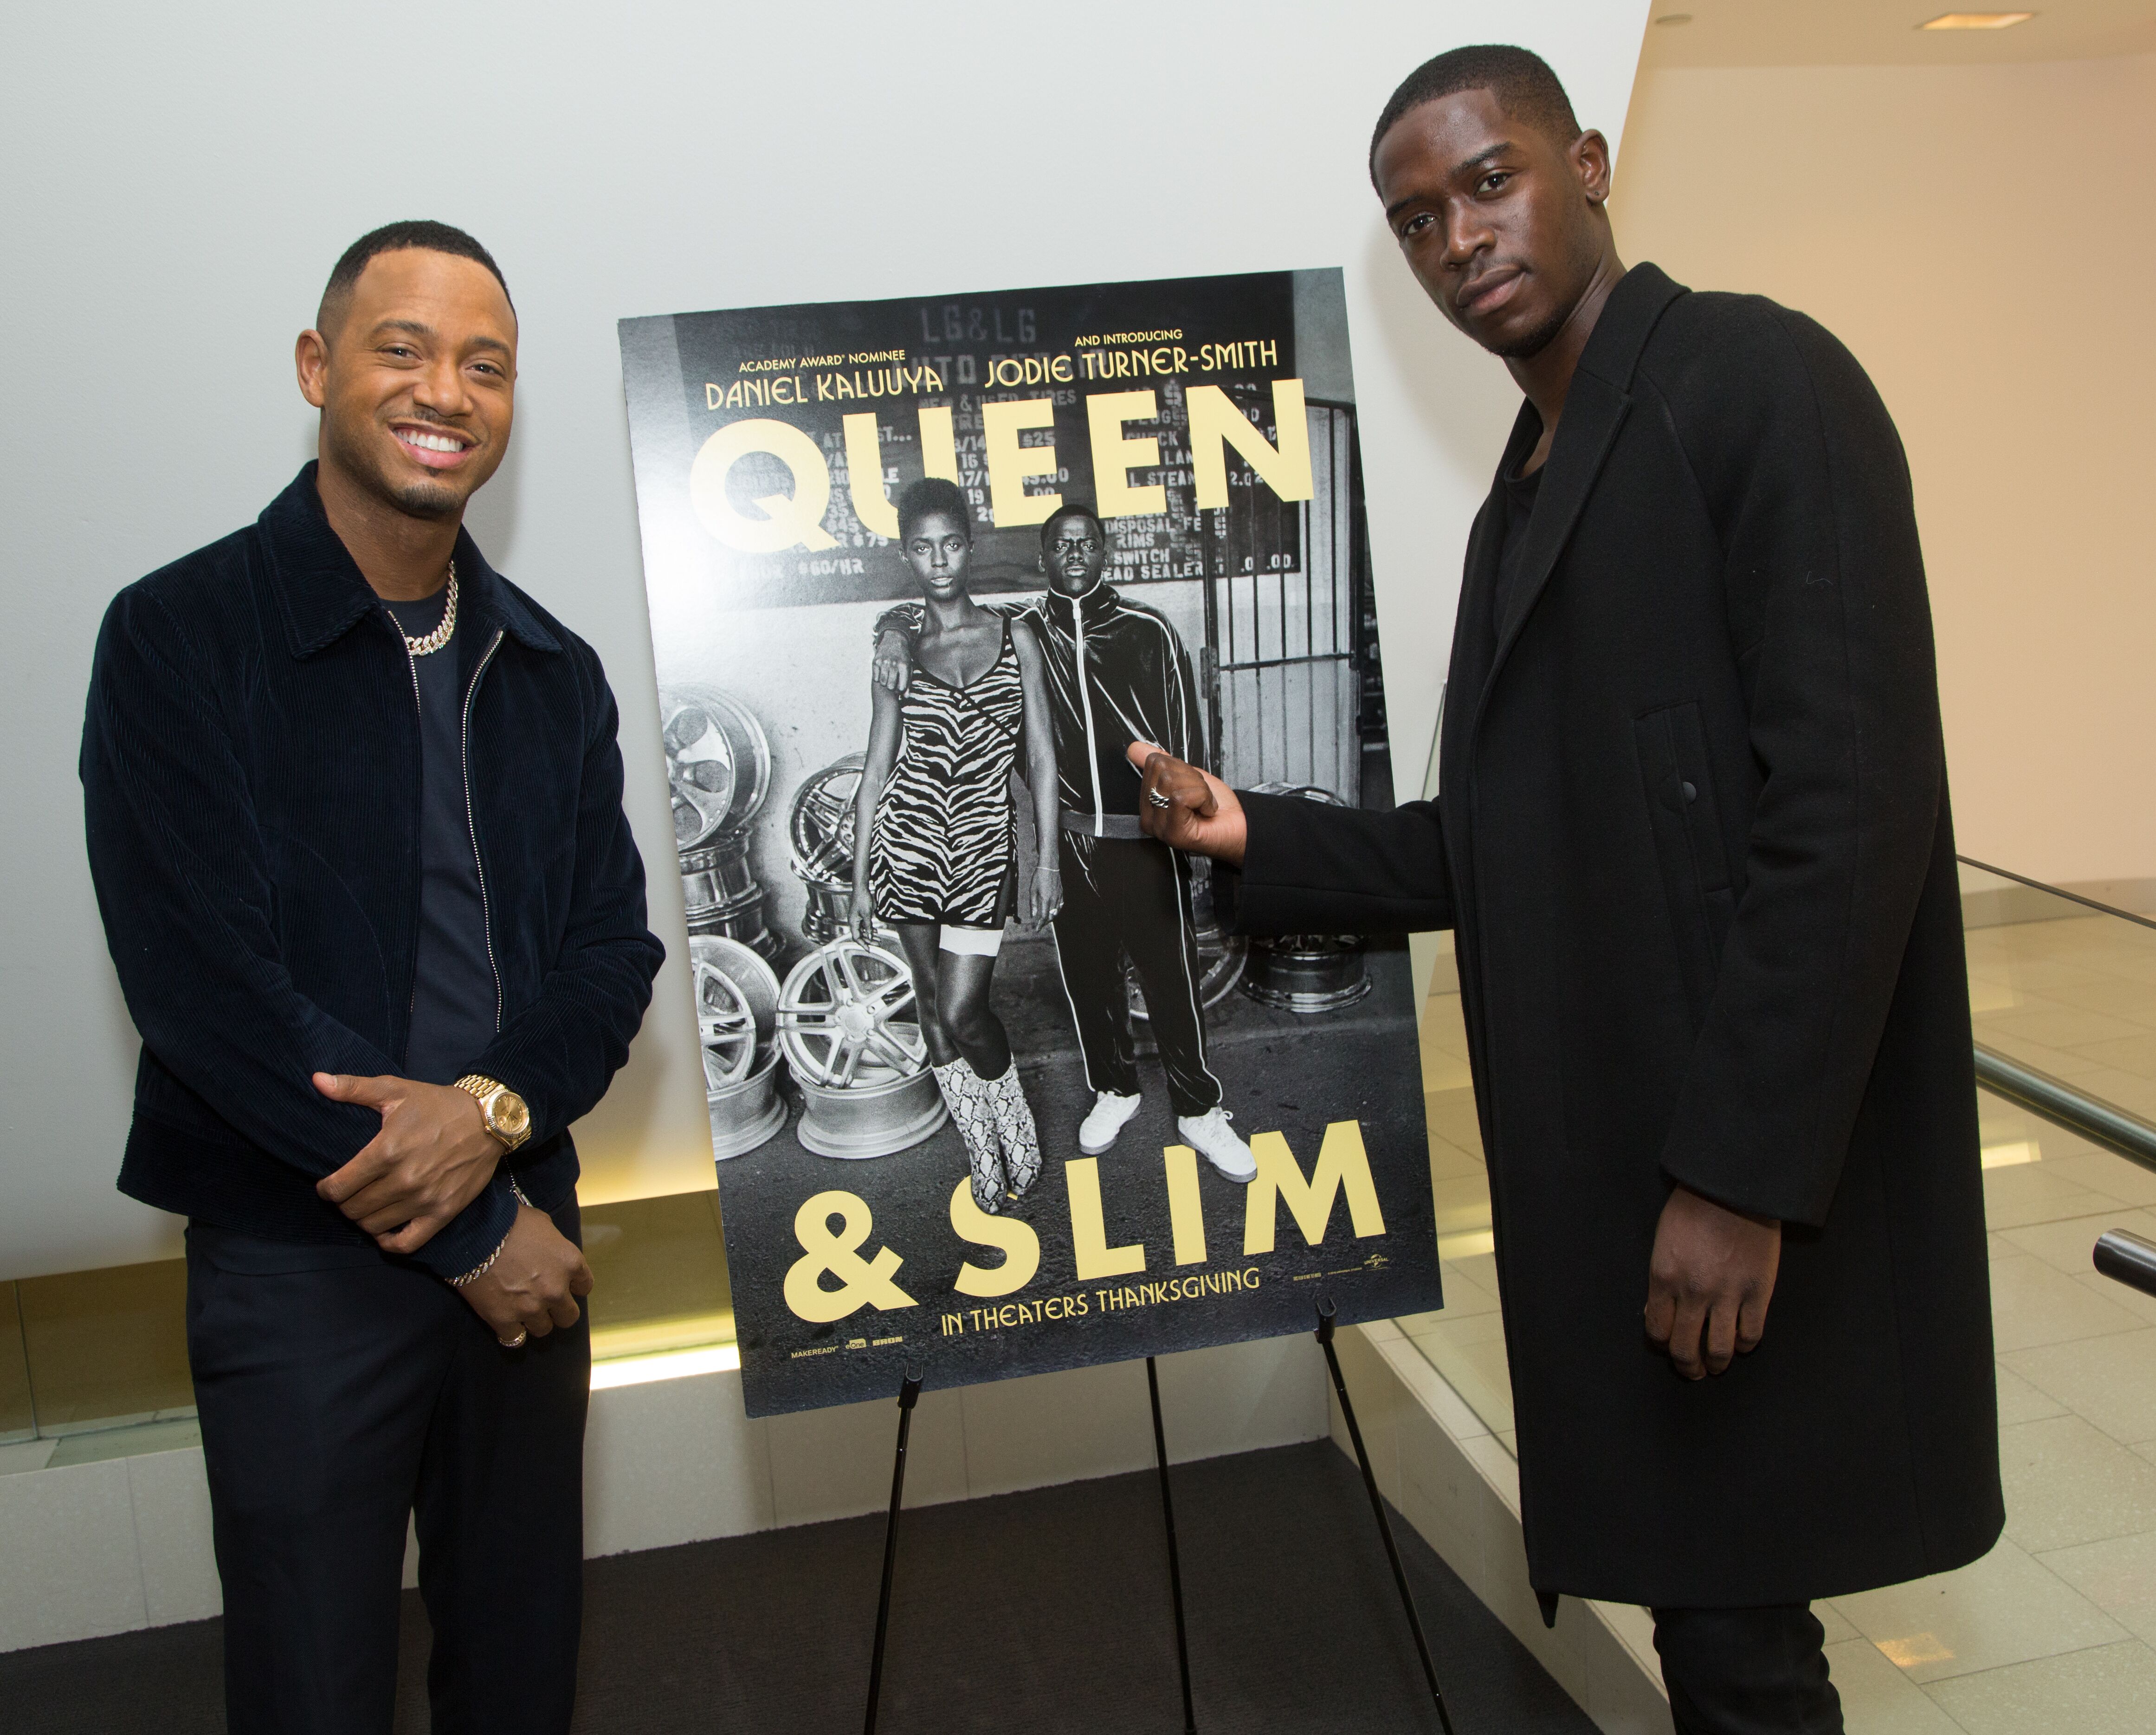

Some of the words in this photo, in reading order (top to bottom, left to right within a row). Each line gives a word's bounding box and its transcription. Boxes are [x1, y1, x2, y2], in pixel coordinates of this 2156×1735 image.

[1075, 335, 1100, 347] AND
[1103, 329, 1183, 344] INTRODUCING
[739, 358, 796, 372] ACADEMY
[848, 349, 905, 363] NOMINEE
[984, 355, 1074, 388] JODIE
[1081, 339, 1278, 380] TURNER-SMITH
[705, 376, 808, 411] DANIEL
[816, 365, 944, 401] KALUUYA
[690, 378, 1315, 554] QUEEN
[1116, 533, 1155, 549] RIMS
[1113, 548, 1170, 565] SWITCH
[1101, 566, 1134, 582] EAD
[783, 1190, 920, 1323] &
[949, 1119, 1387, 1297] SLIM
[1364, 1257, 1389, 1265] UNIVERSAL
[942, 1313, 963, 1336] IN
[969, 1294, 1088, 1331] THEATERS
[1096, 1267, 1259, 1312] THANKSGIVING
